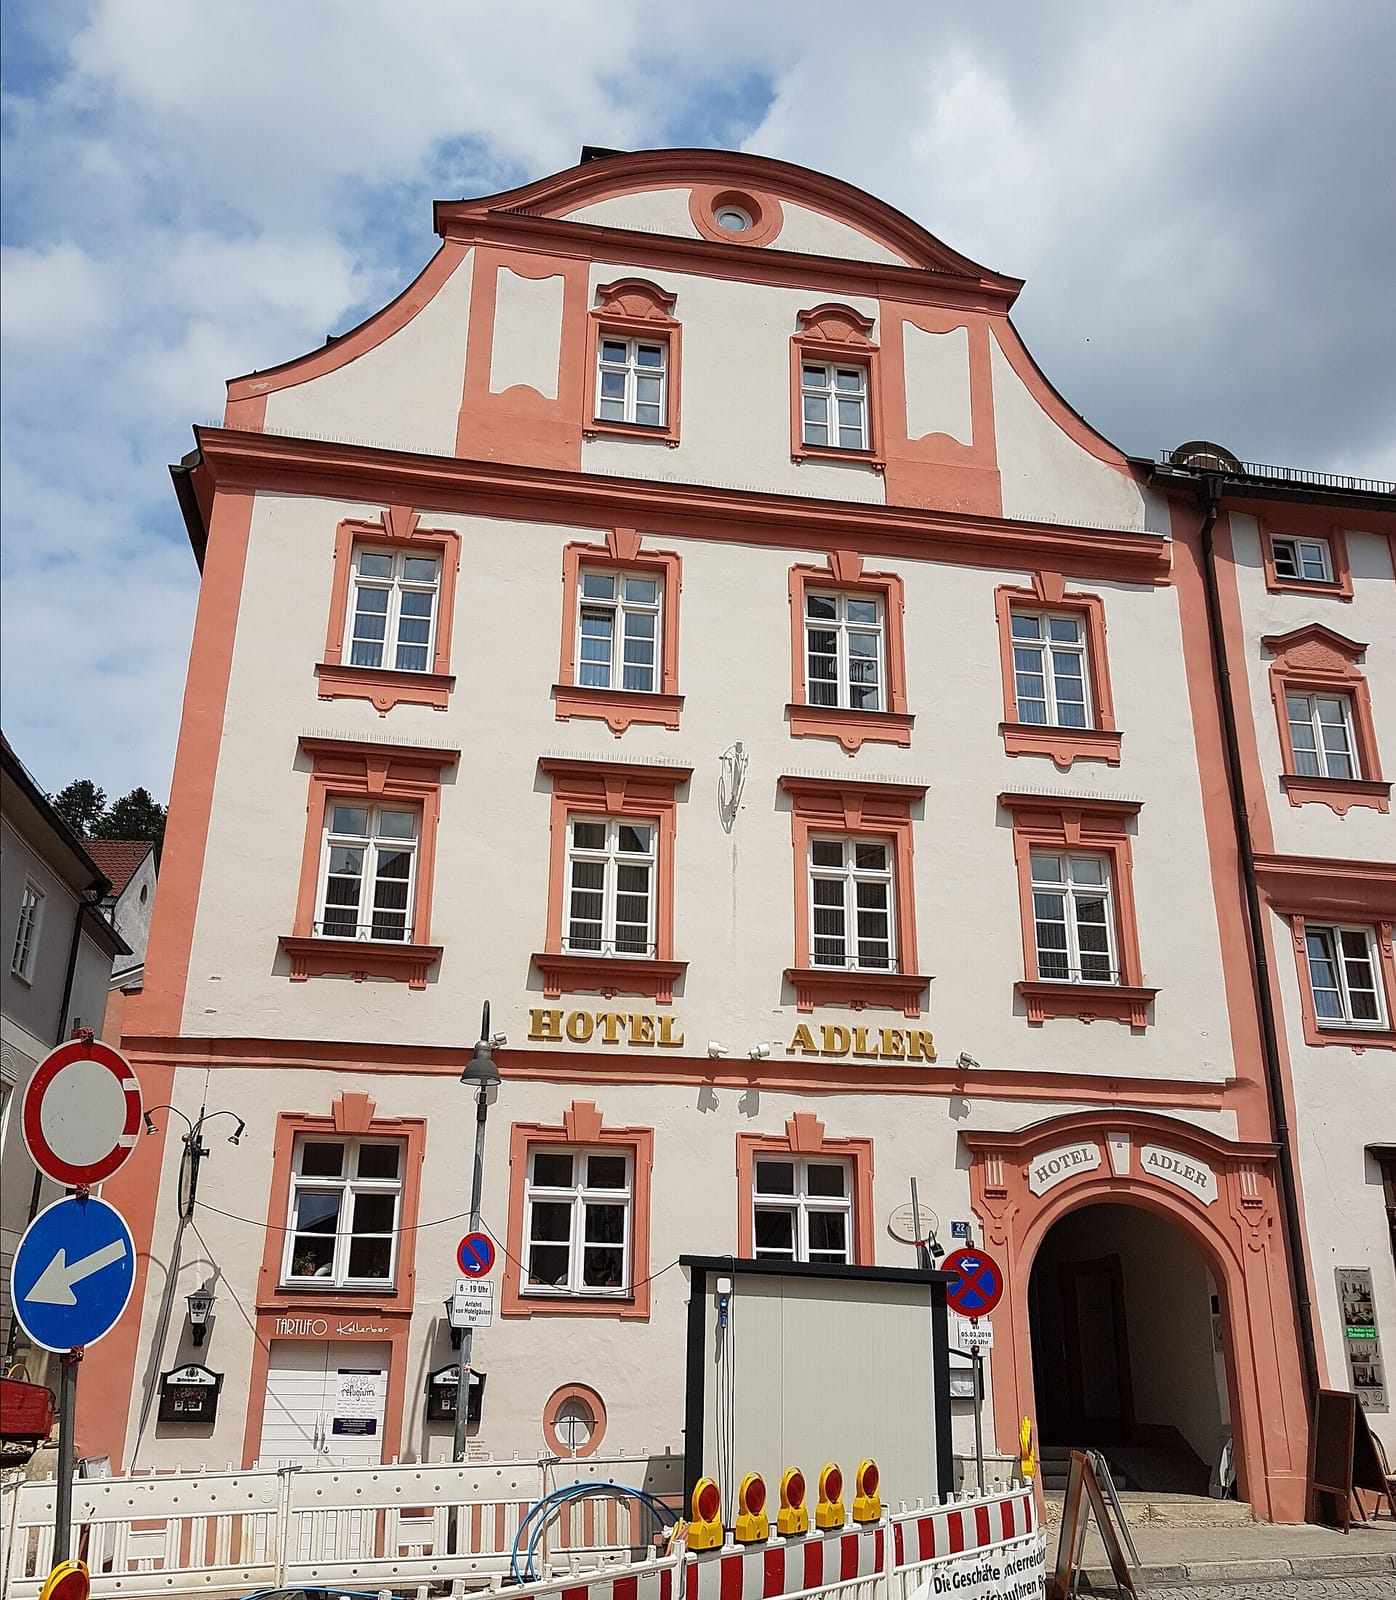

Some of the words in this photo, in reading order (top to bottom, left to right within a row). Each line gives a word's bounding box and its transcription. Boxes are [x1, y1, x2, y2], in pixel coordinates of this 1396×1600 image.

[528, 1008, 685, 1048] HOTEL
[785, 1023, 938, 1063] ADLER
[1034, 1148, 1094, 1183] HOTEL
[1147, 1152, 1208, 1189] ADLER
[955, 1223, 965, 1232] 22
[460, 1284, 464, 1292] 6
[469, 1285, 477, 1293] 19
[275, 1318, 328, 1336] TARTUFO
[934, 1574, 951, 1595] Die
[952, 1563, 1001, 1590] Geschäfte
